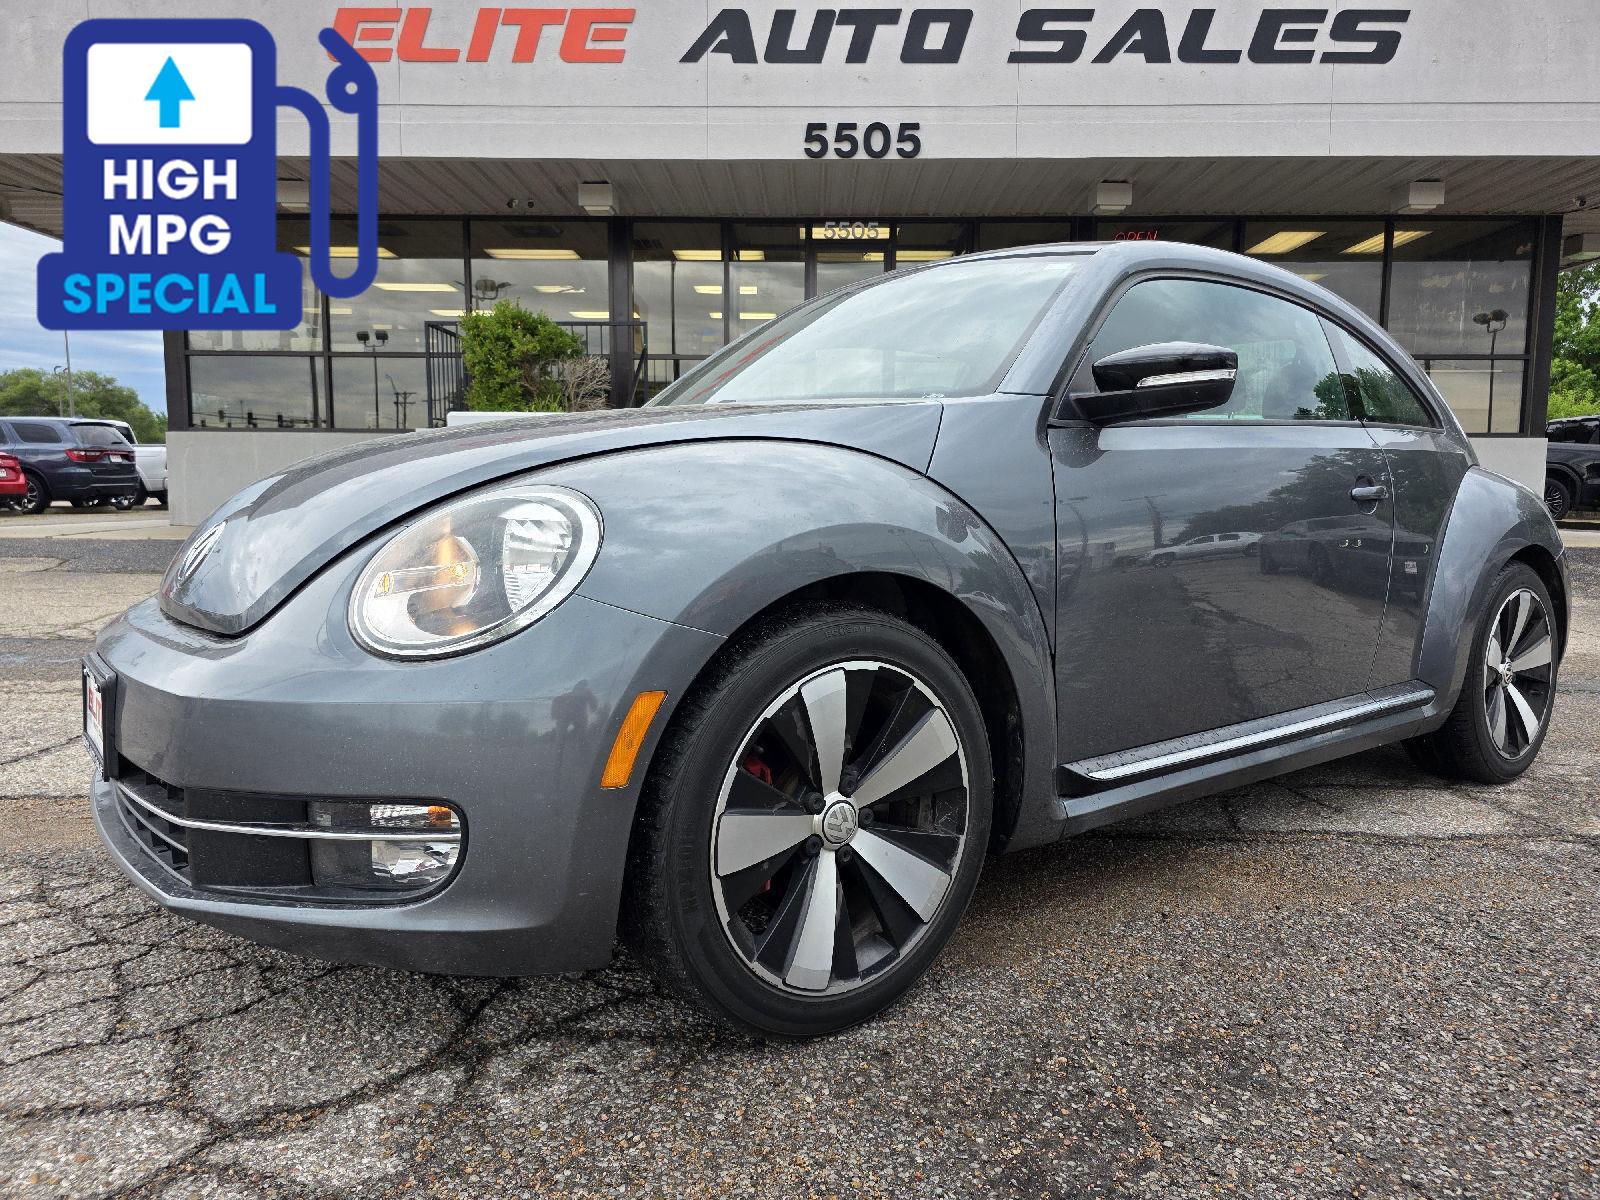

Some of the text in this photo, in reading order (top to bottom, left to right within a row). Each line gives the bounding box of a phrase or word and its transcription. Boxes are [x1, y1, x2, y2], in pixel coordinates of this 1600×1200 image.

[329, 8, 1411, 64] ELITE AUTO SALES
[804, 122, 921, 158] 5505
[823, 221, 880, 240] 5505
[1114, 230, 1159, 241] OPEN
